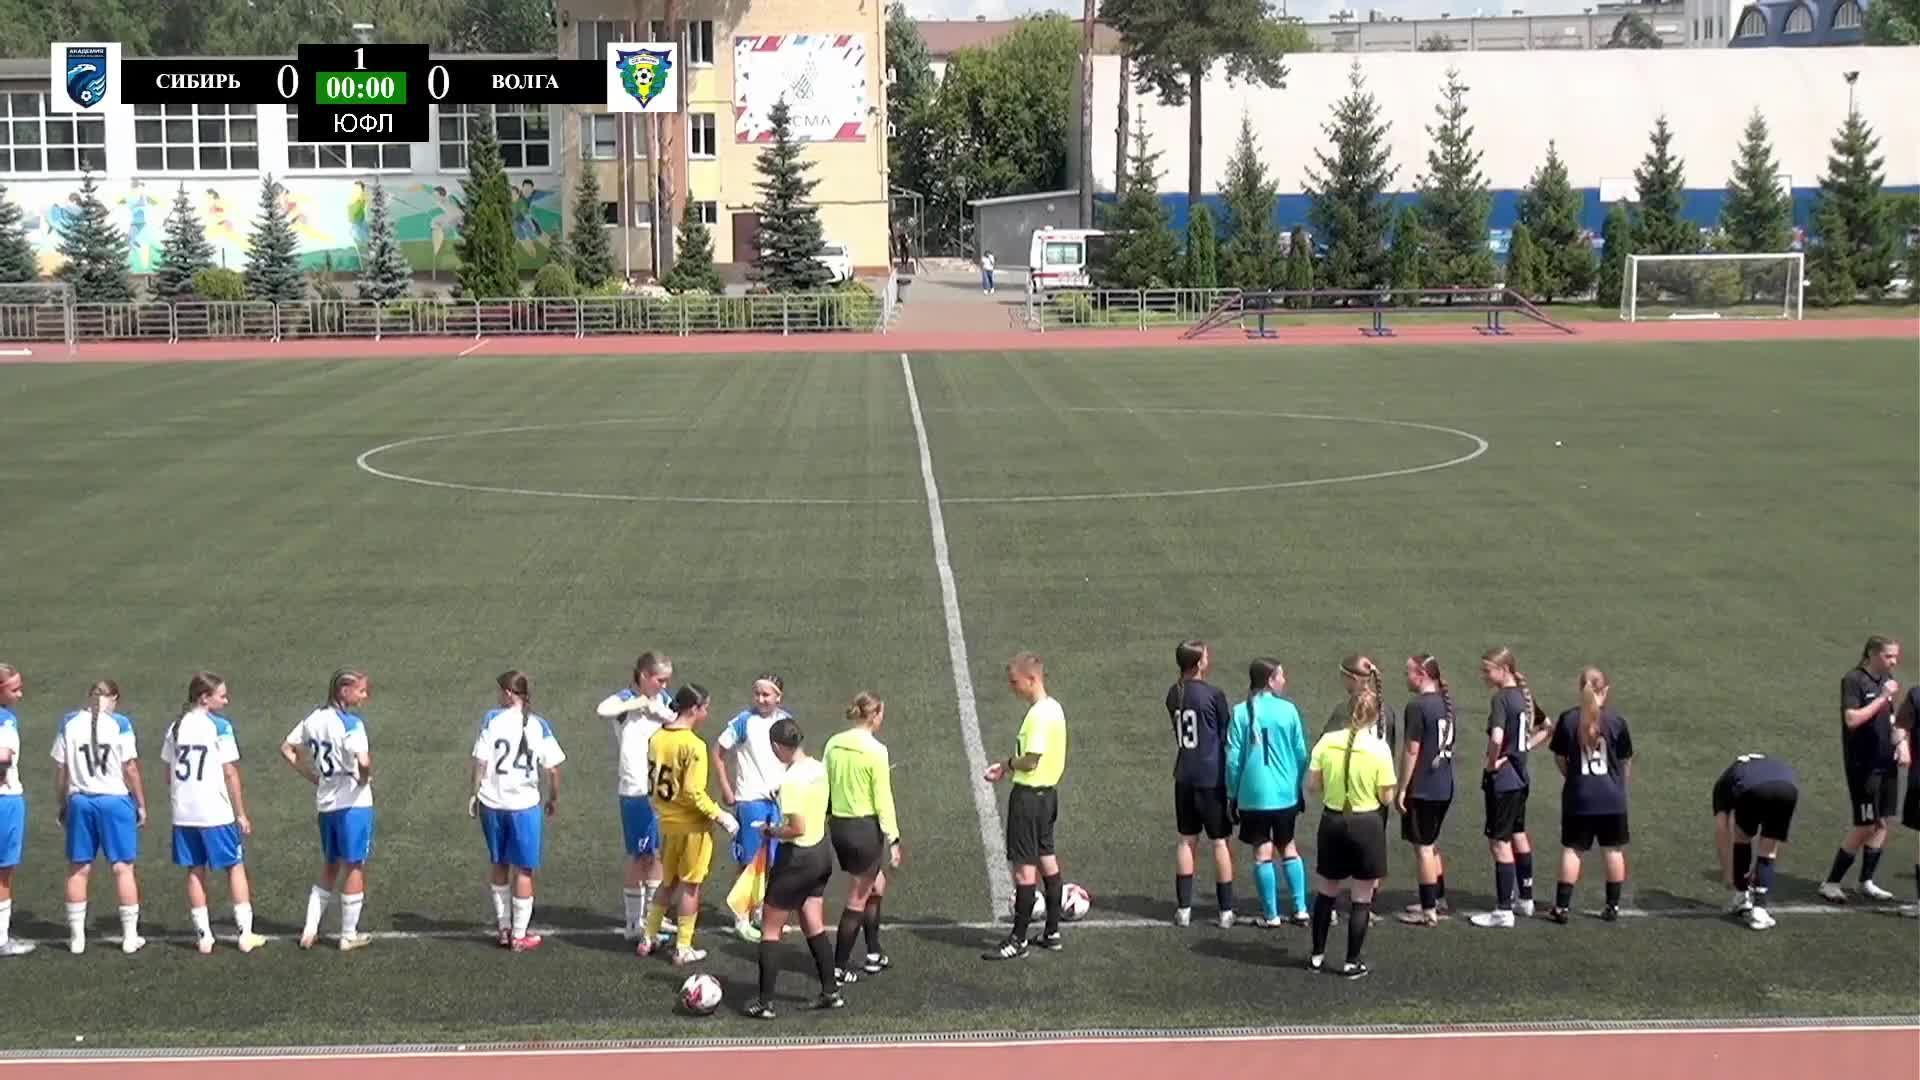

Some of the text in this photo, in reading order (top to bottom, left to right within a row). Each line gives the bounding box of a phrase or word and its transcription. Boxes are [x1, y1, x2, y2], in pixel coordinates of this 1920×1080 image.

[1175, 709, 1198, 749] 13
[175, 744, 208, 781] 37
[494, 738, 534, 778] 24
